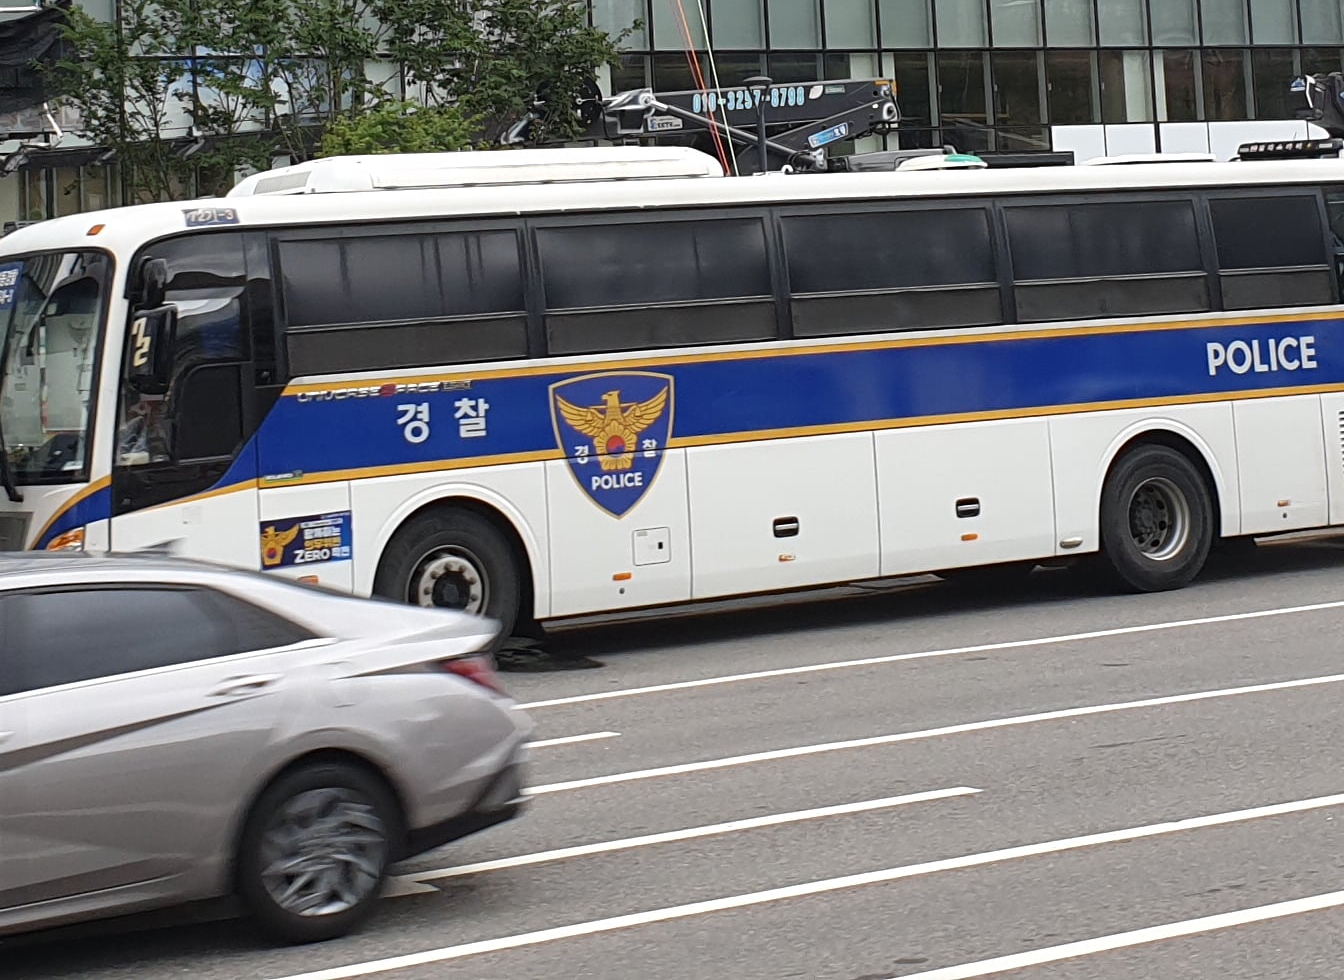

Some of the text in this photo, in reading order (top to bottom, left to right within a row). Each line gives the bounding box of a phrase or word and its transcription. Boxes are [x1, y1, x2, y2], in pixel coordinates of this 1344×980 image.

[1207, 336, 1317, 376] POLICE
[591, 472, 643, 490] POLICE
[294, 548, 330, 563] ZERO
